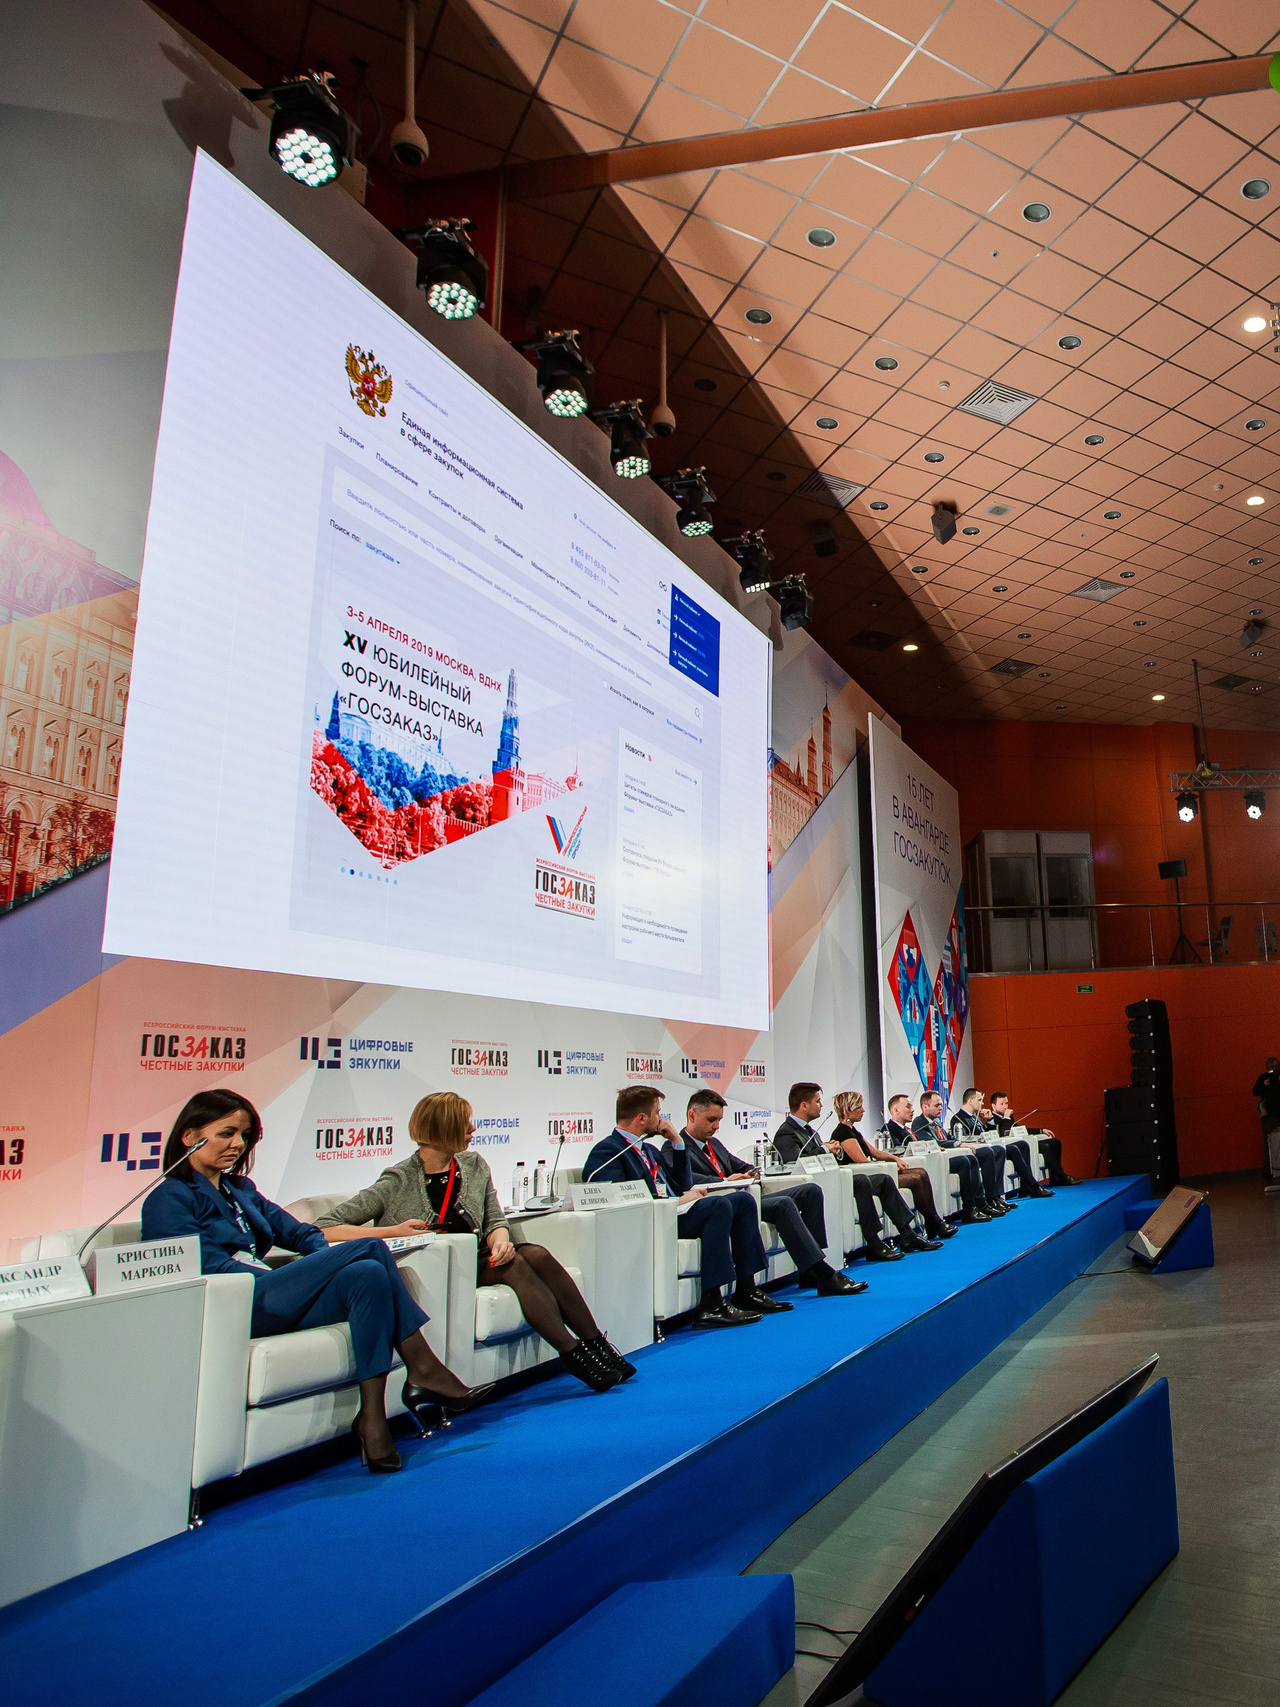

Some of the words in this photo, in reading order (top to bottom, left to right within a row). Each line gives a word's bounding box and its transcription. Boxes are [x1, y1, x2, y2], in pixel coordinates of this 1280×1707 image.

[338, 426, 364, 450] Закупки
[400, 428, 406, 437] в
[408, 434, 432, 456] сфере
[434, 452, 464, 480] закупок
[401, 412, 431, 440] Единая
[432, 436, 496, 490] информационная
[496, 484, 524, 510] система
[376, 452, 418, 487] Планирование
[329, 518, 350, 537] Поиск
[346, 605, 364, 623] 3-5
[367, 616, 409, 646] АПРЕЛЯ
[411, 638, 433, 658] 2019
[435, 650, 476, 682] МОСКВА,
[478, 672, 502, 693] ВДНХ
[342, 629, 368, 655] XV
[373, 644, 472, 705] ЮБИЛЕЙНЫЙ
[341, 661, 484, 738] ФОРУМ-ВЫСТАВКА
[339, 692, 439, 742] «ГОСЗАКАЗ»
[907, 774, 917, 799] 15
[919, 783, 934, 812] ЛЕТ
[892, 794, 900, 819] В
[902, 802, 950, 857] АВАНГАРДЕ
[894, 830, 952, 886] ГОСЗАКУПОК
[535, 869, 596, 905] ГОСЗАКАЗ
[535, 892, 566, 909] ЧЕСТНЫЕ
[567, 900, 596, 916] ЗАКУПКИ
[143, 1022, 194, 1030] ВСЕРОССИЙСКИЙ
[140, 1034, 246, 1060] ГОСЗАКАЗ
[349, 1038, 414, 1052] ЦИФРОВЫЕ
[140, 1060, 193, 1071] ЧЕСТНЫЕ
[196, 1061, 245, 1072] ЗАКУПКИ
[348, 1058, 400, 1070] ЗАКУПКИ
[452, 1048, 508, 1067] ГОСЗАКАЗ
[566, 1051, 604, 1061] ЦИФРОВЫЕ
[626, 1058, 663, 1073] ГОСЗАКАЗ
[700, 1060, 725, 1068] ЦИФРОВЫЕ
[451, 1067, 480, 1076] ЧЕСТНЫЕ
[481, 1068, 508, 1076] ЗАКУПКИ
[566, 1066, 597, 1075] ЗАКУПКИ
[700, 1071, 721, 1079] ЗАКУПКИ
[740, 1064, 765, 1077] ГОСЗАКАЗ
[549, 1119, 593, 1135] ГОСЗАКАЗ
[316, 1126, 393, 1149] ГОСЗАКАЗ
[471, 1134, 510, 1146] ЗАКУПКИ
[316, 1150, 354, 1161] ЧЕСТНЫЕ
[356, 1148, 393, 1158] ЗАКУПКИ
[116, 1244, 185, 1264] КРИСТИНА
[121, 1262, 182, 1282] МАРКОВА
